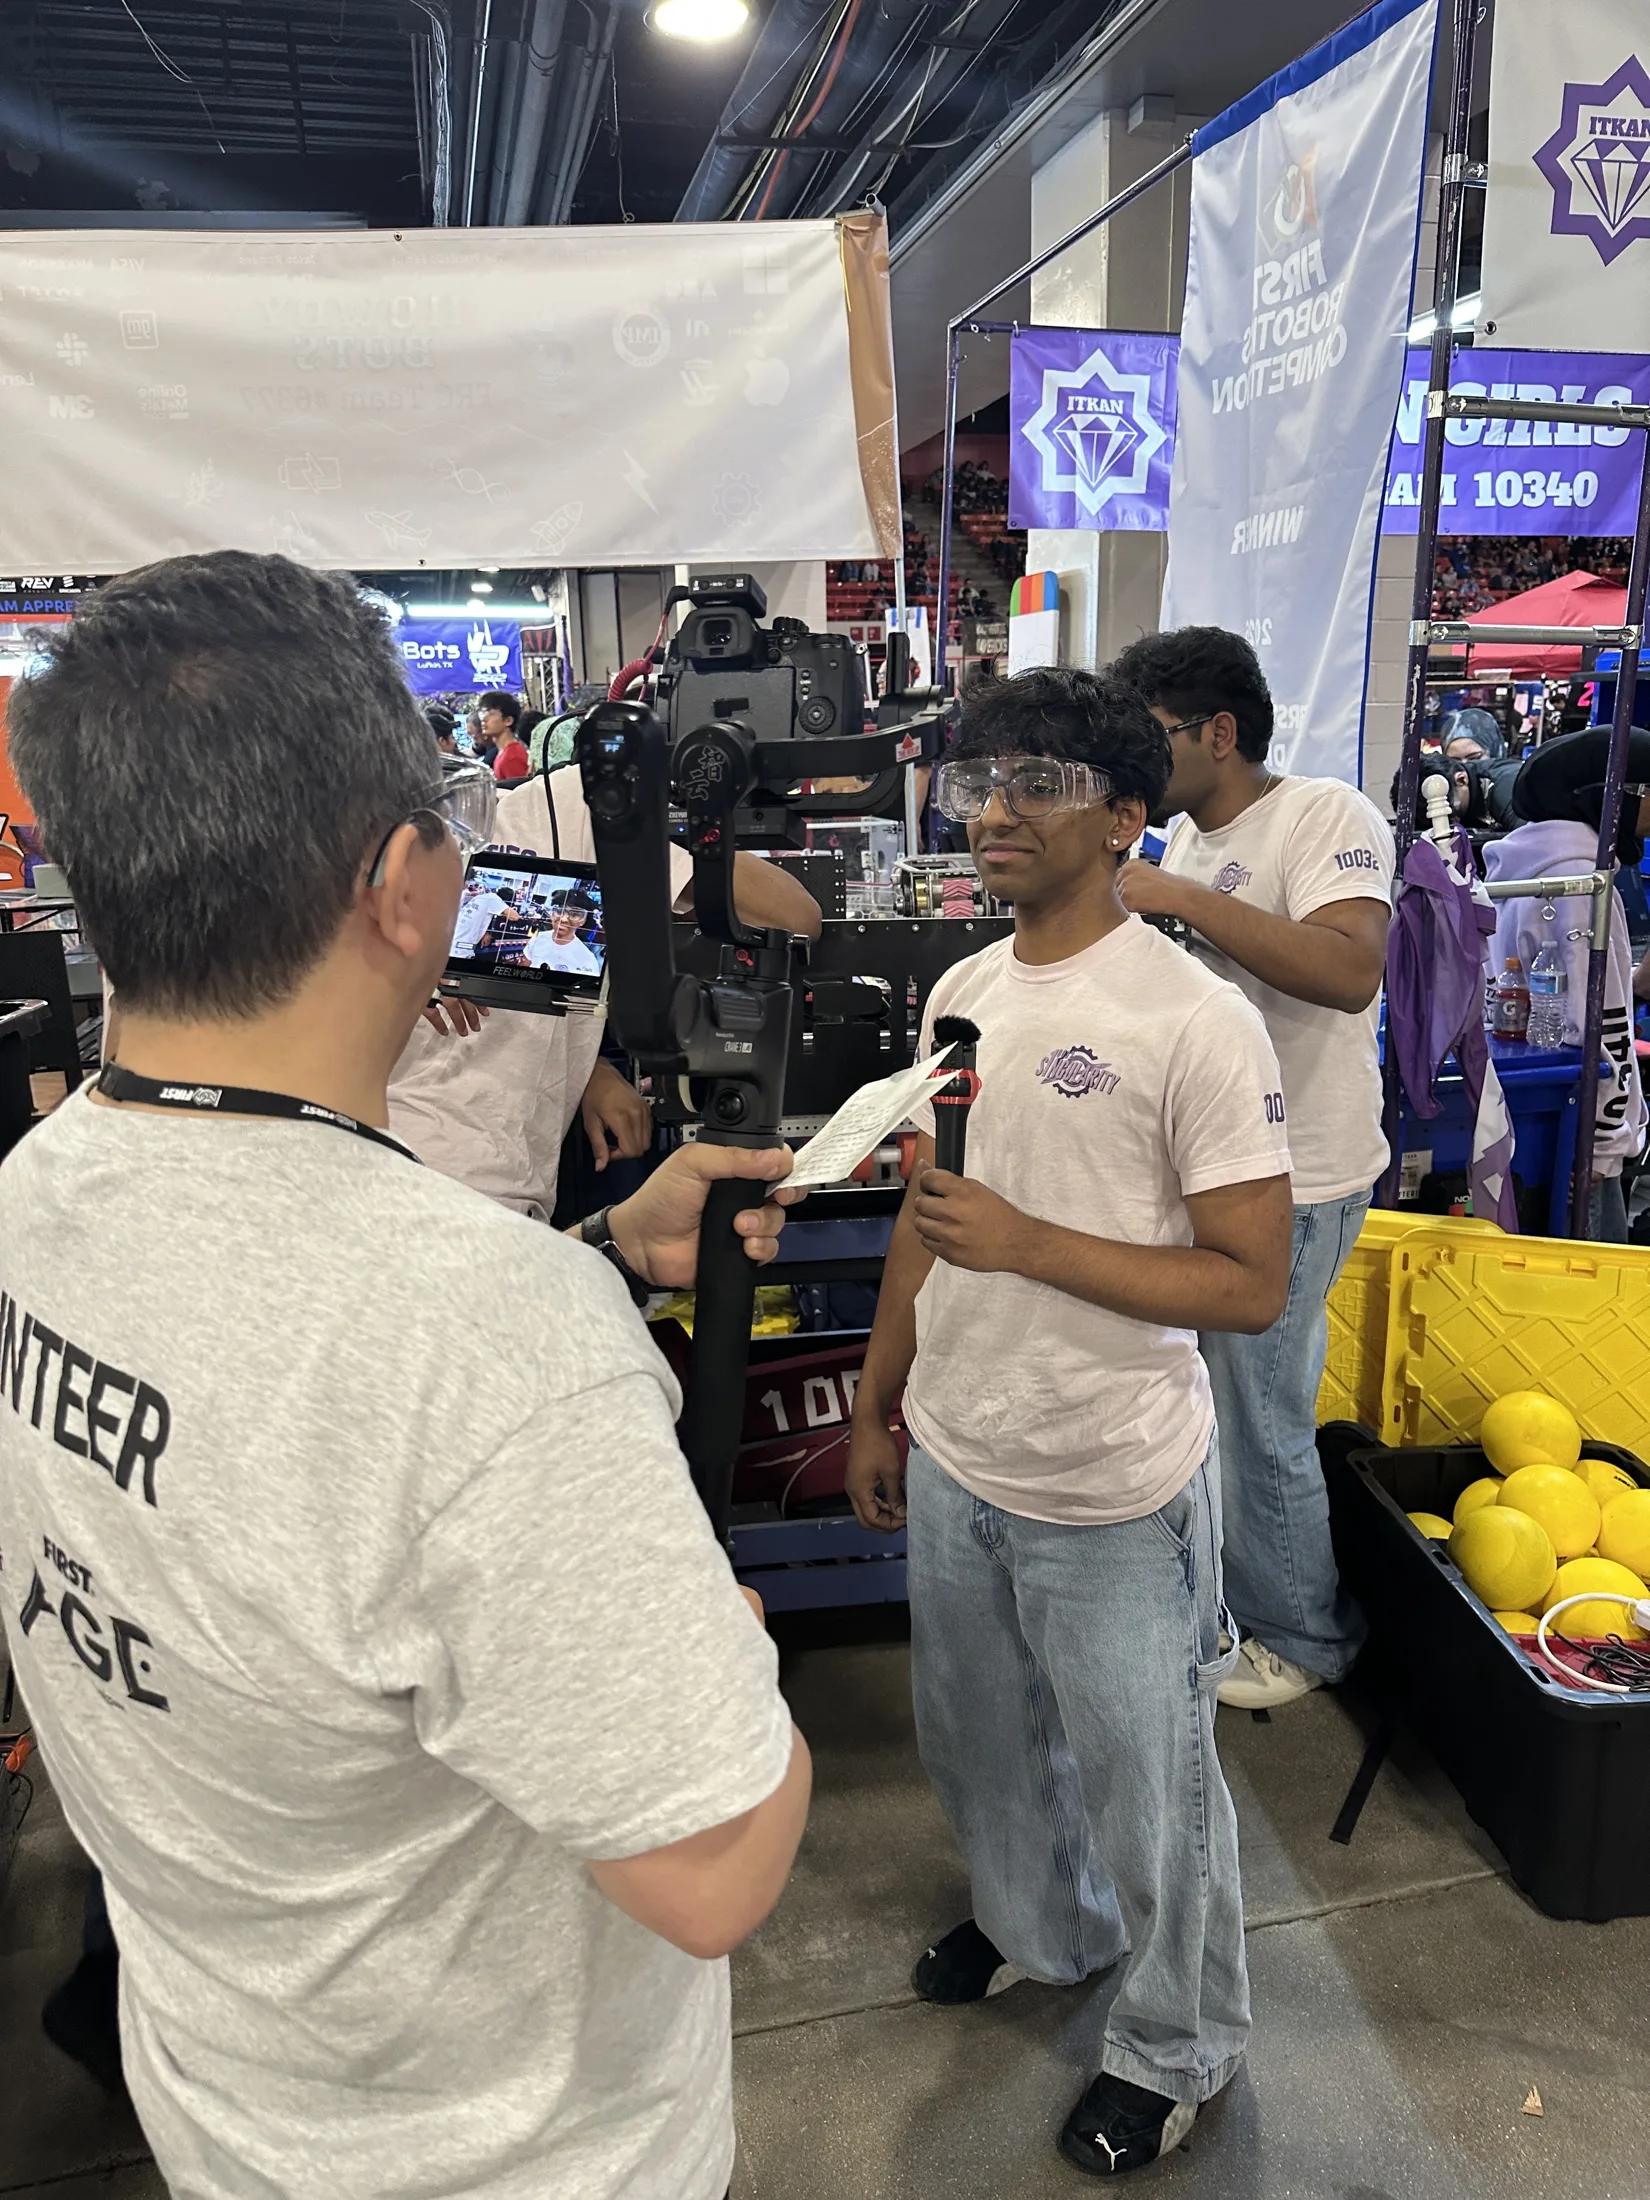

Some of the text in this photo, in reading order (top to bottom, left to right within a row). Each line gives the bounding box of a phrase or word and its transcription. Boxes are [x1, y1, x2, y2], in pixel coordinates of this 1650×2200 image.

[1067, 395, 1124, 414] ITKAN
[1444, 381, 1633, 447] GIRLS
[1473, 470, 1599, 508] 10340
[21, 577, 54, 589] REV
[403, 641, 461, 660] Bots
[1035, 1055, 1121, 1095] SINGULARITY
[159, 1087, 194, 1102] FIRST
[300, 1104, 335, 1120] FIRST
[43, 1534, 95, 1597] FIRST
